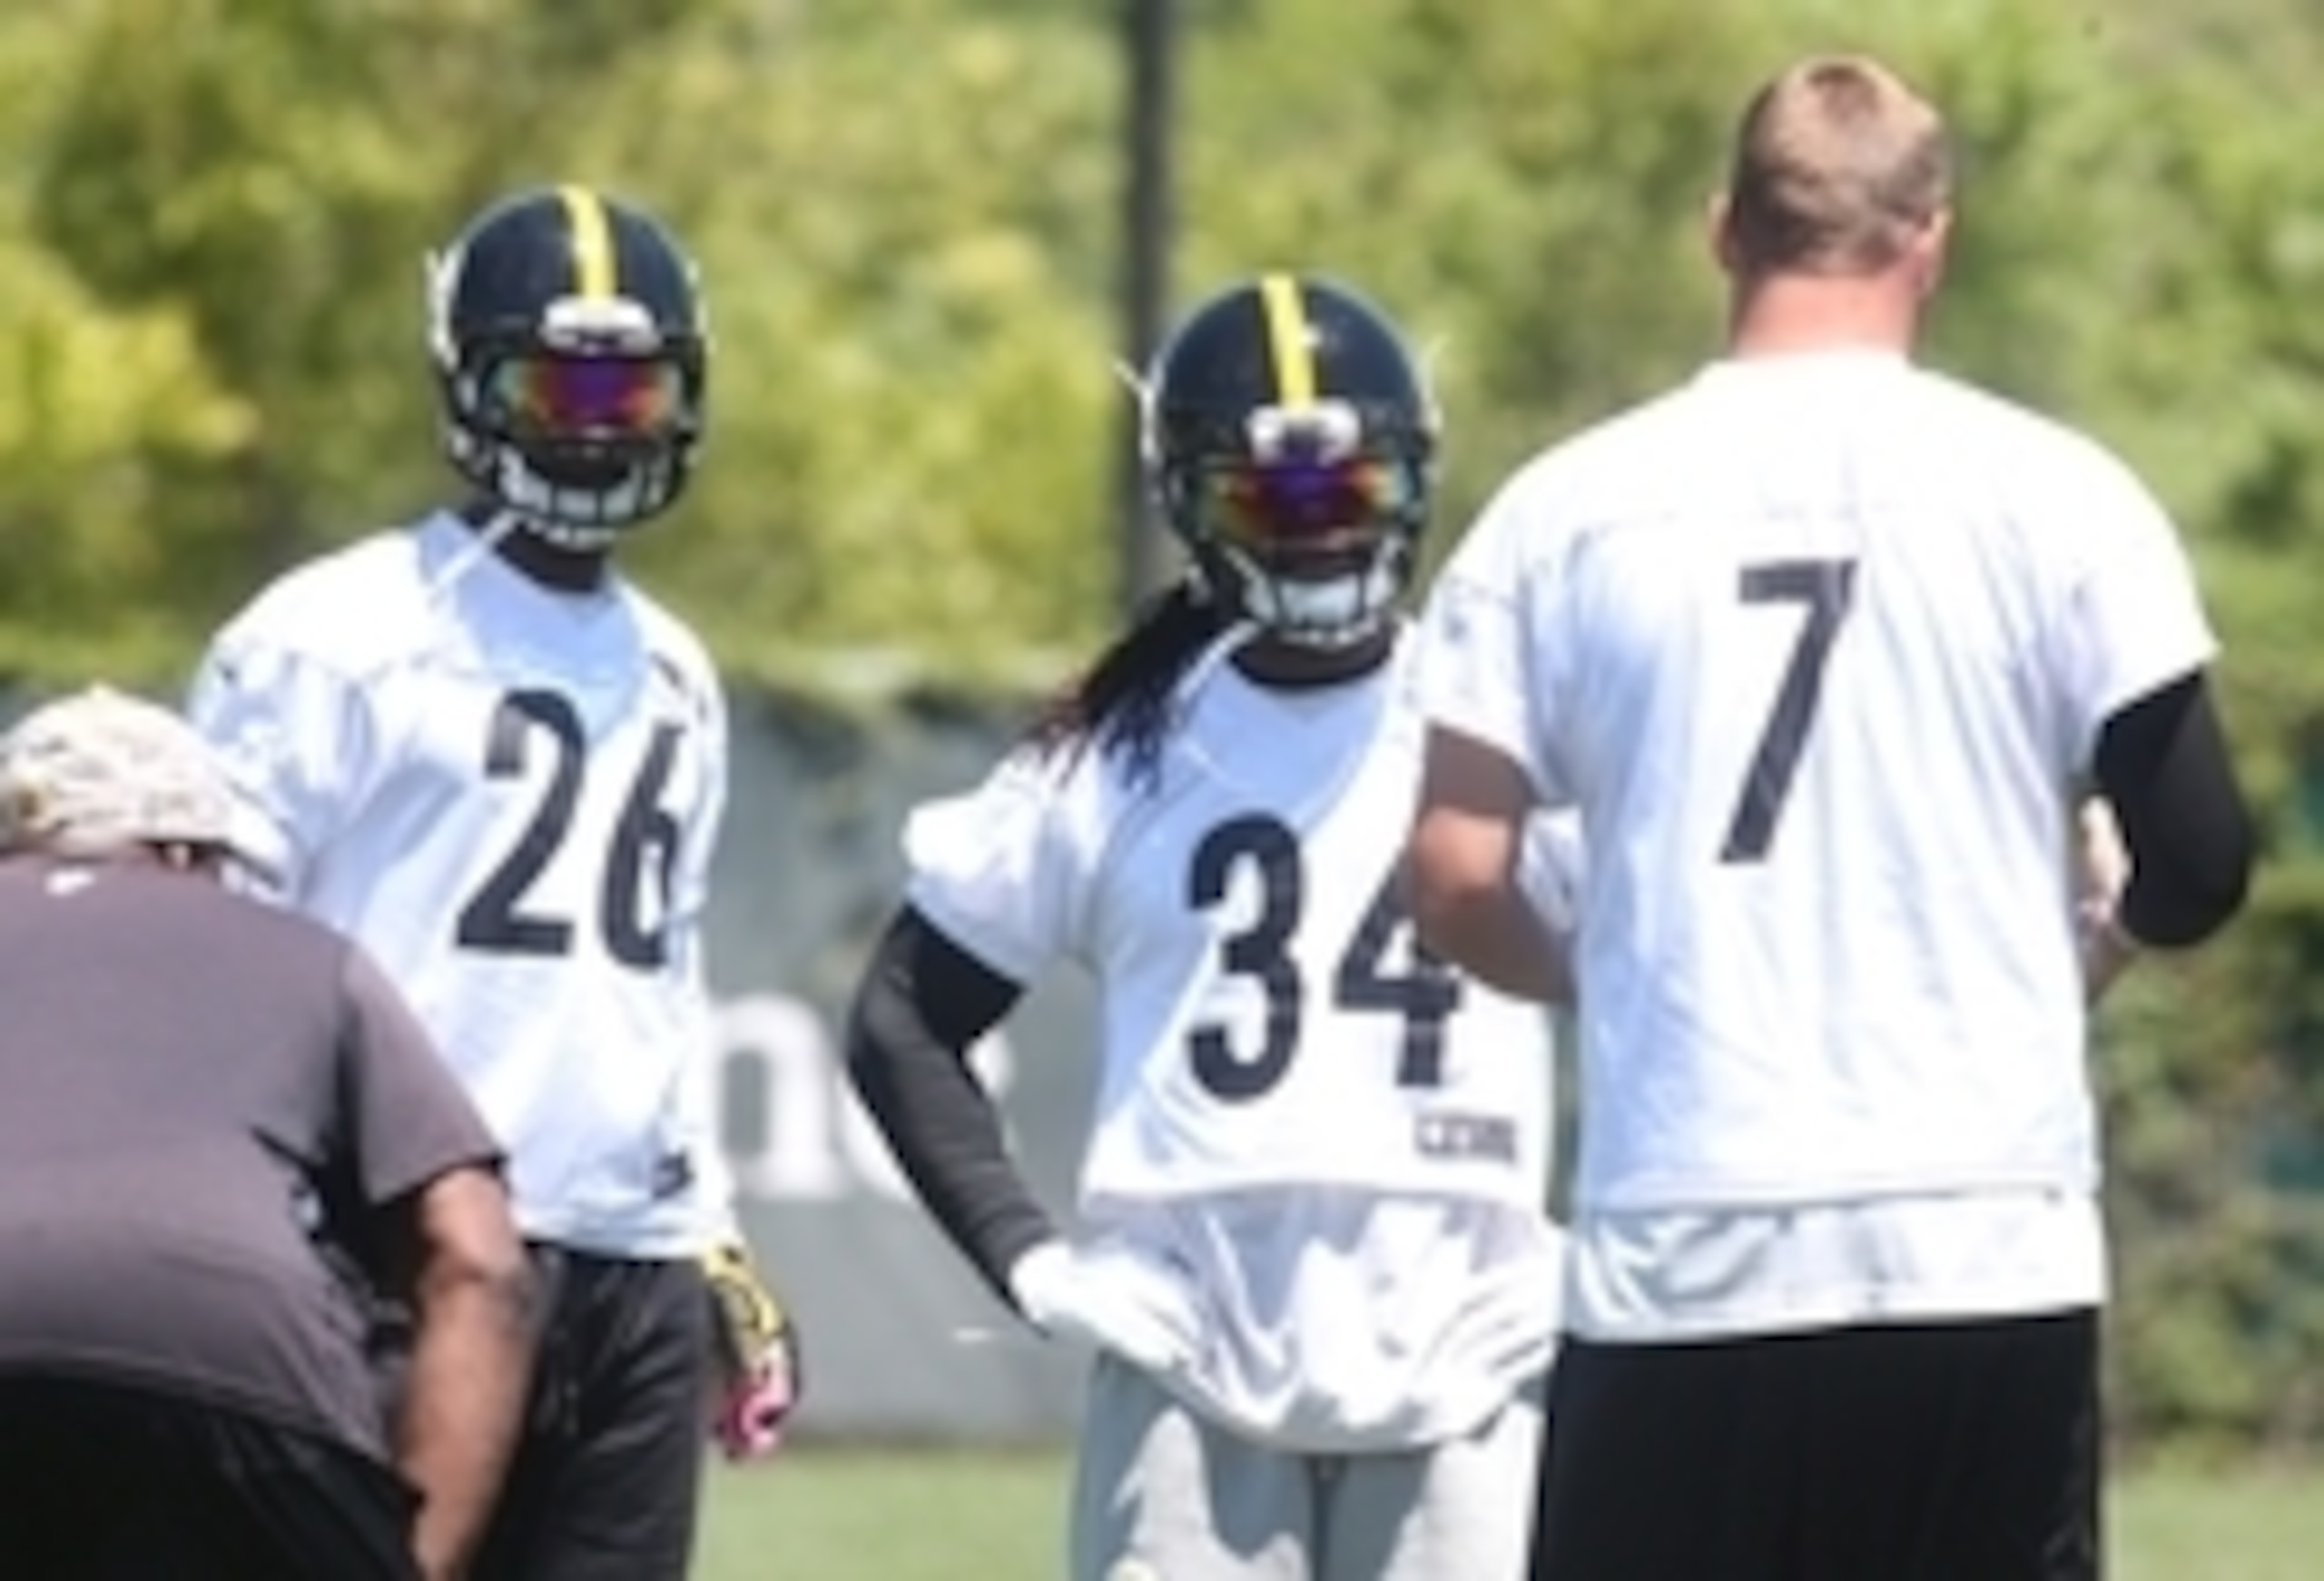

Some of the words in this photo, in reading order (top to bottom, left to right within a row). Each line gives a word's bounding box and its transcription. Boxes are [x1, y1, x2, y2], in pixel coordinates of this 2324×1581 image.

[456, 689, 683, 971] 26
[1720, 559, 1857, 864] 7
[1185, 809, 1464, 1103] 34
